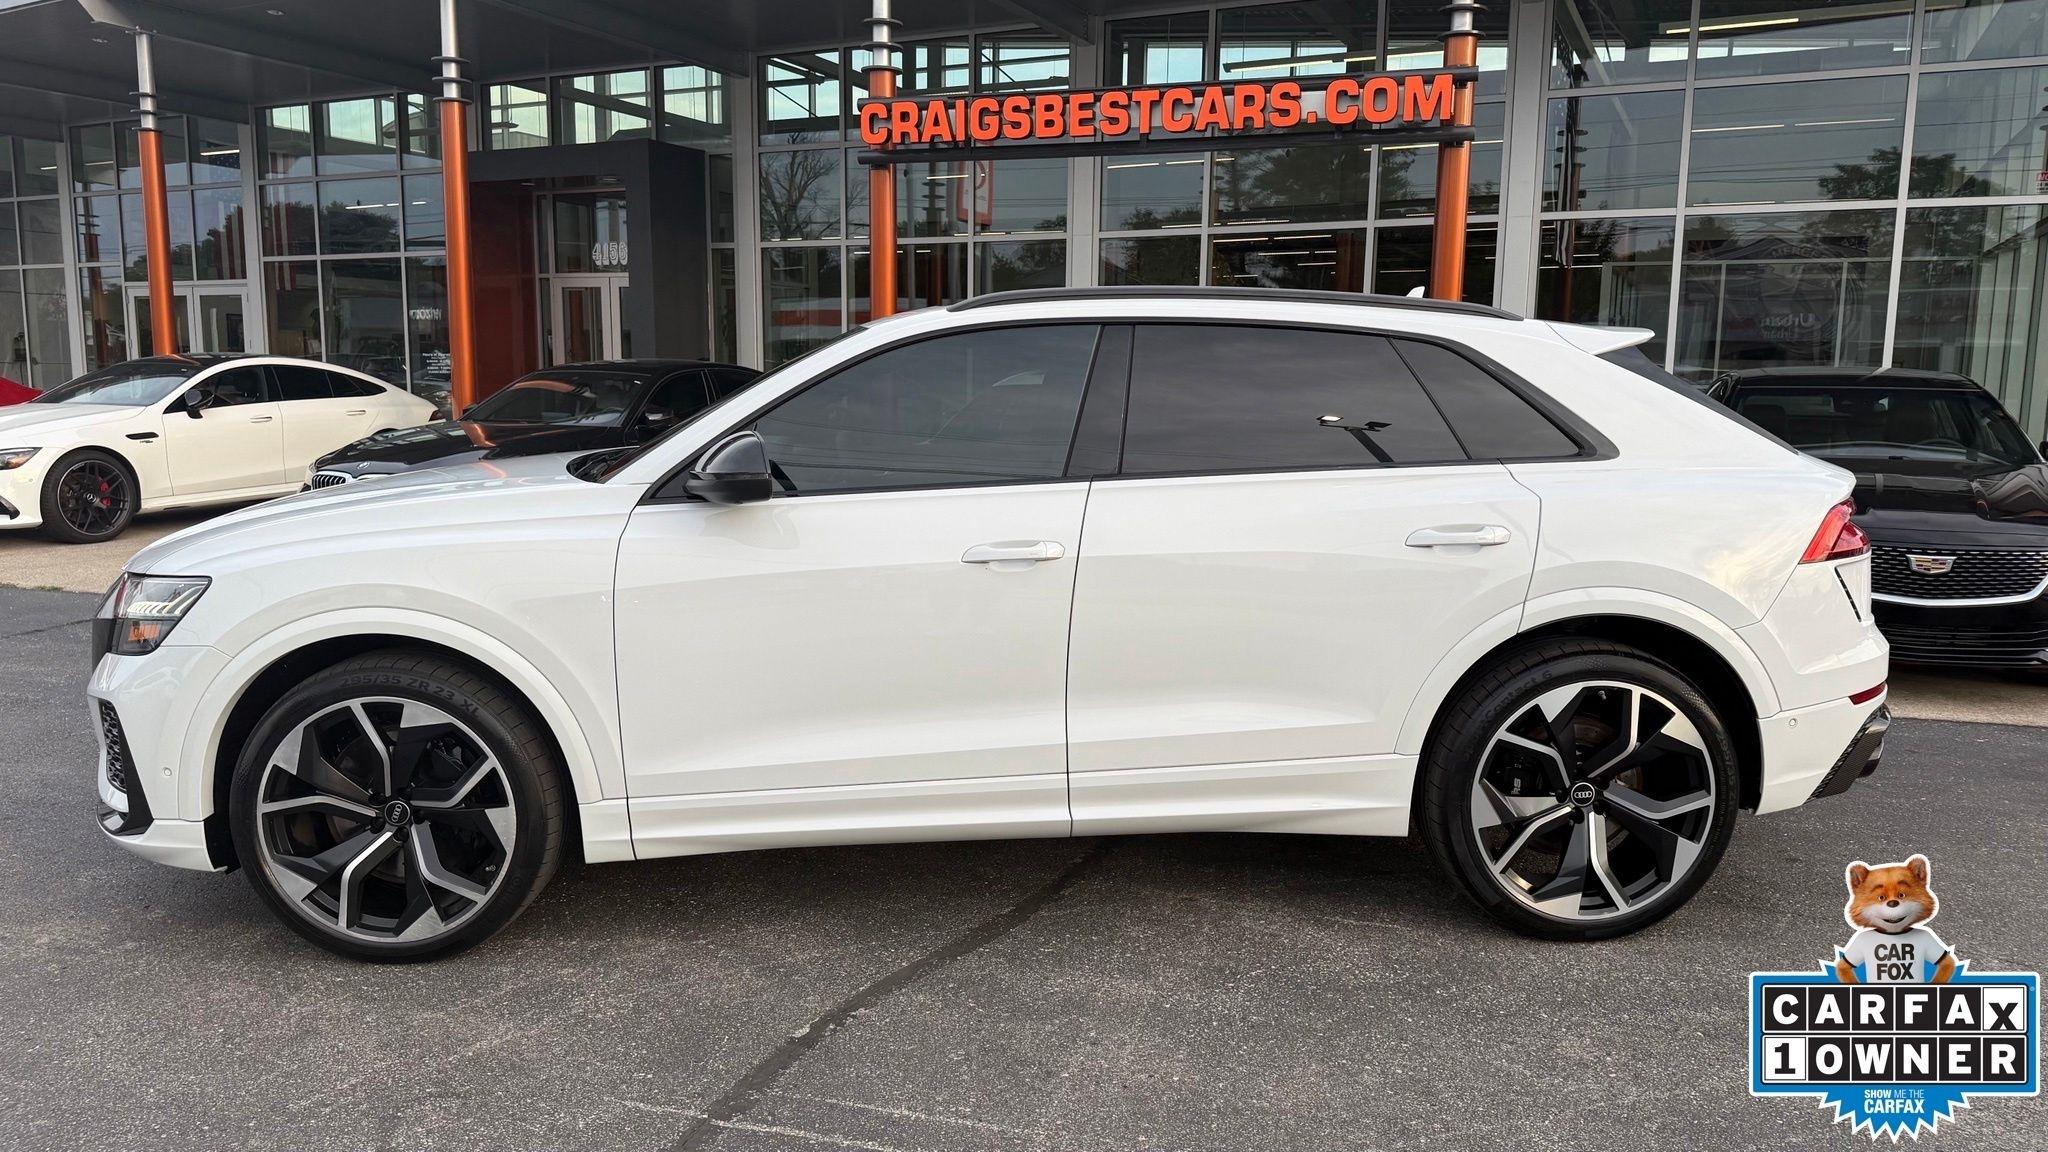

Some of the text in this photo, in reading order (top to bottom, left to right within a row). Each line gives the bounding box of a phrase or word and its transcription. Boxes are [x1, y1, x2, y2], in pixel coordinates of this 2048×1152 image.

[860, 74, 1454, 145] CRAIGSBESTCARS.COM
[406, 677, 430, 692] ZR
[433, 686, 456, 701] 23
[1511, 777, 1521, 795] RS
